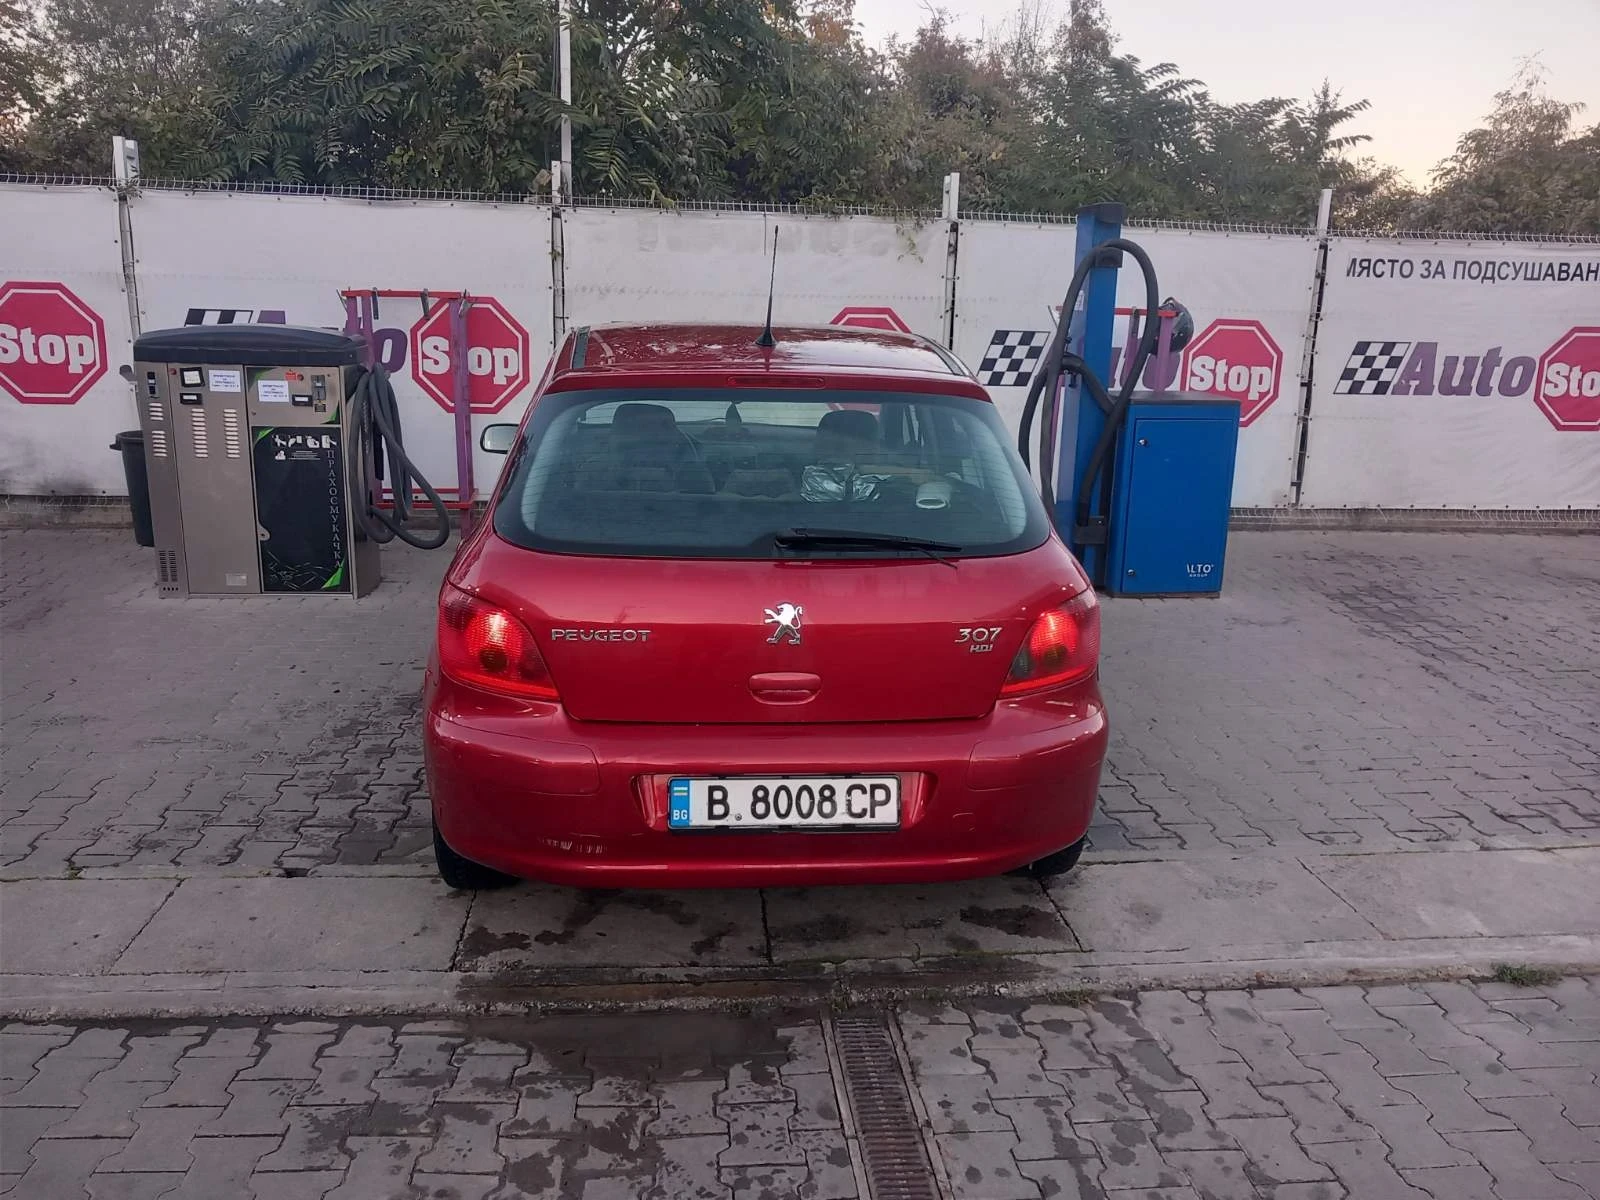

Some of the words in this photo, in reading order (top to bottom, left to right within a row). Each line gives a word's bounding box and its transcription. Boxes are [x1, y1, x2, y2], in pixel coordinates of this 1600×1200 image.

[1419, 259, 1446, 280] ЗА
[1453, 260, 1600, 284] ПОДСУШАВАН
[0, 323, 95, 374] Stop
[421, 336, 519, 385] Sop
[1189, 355, 1271, 400] Stop
[1391, 341, 1537, 397] Auto
[1544, 362, 1600, 397] Sto
[551, 628, 651, 642] PEUGEOT
[954, 627, 1003, 643] 307
[673, 809, 688, 820] BG
[707, 785, 730, 820] B
[750, 784, 838, 820] 8008
[846, 783, 892, 819] CP
